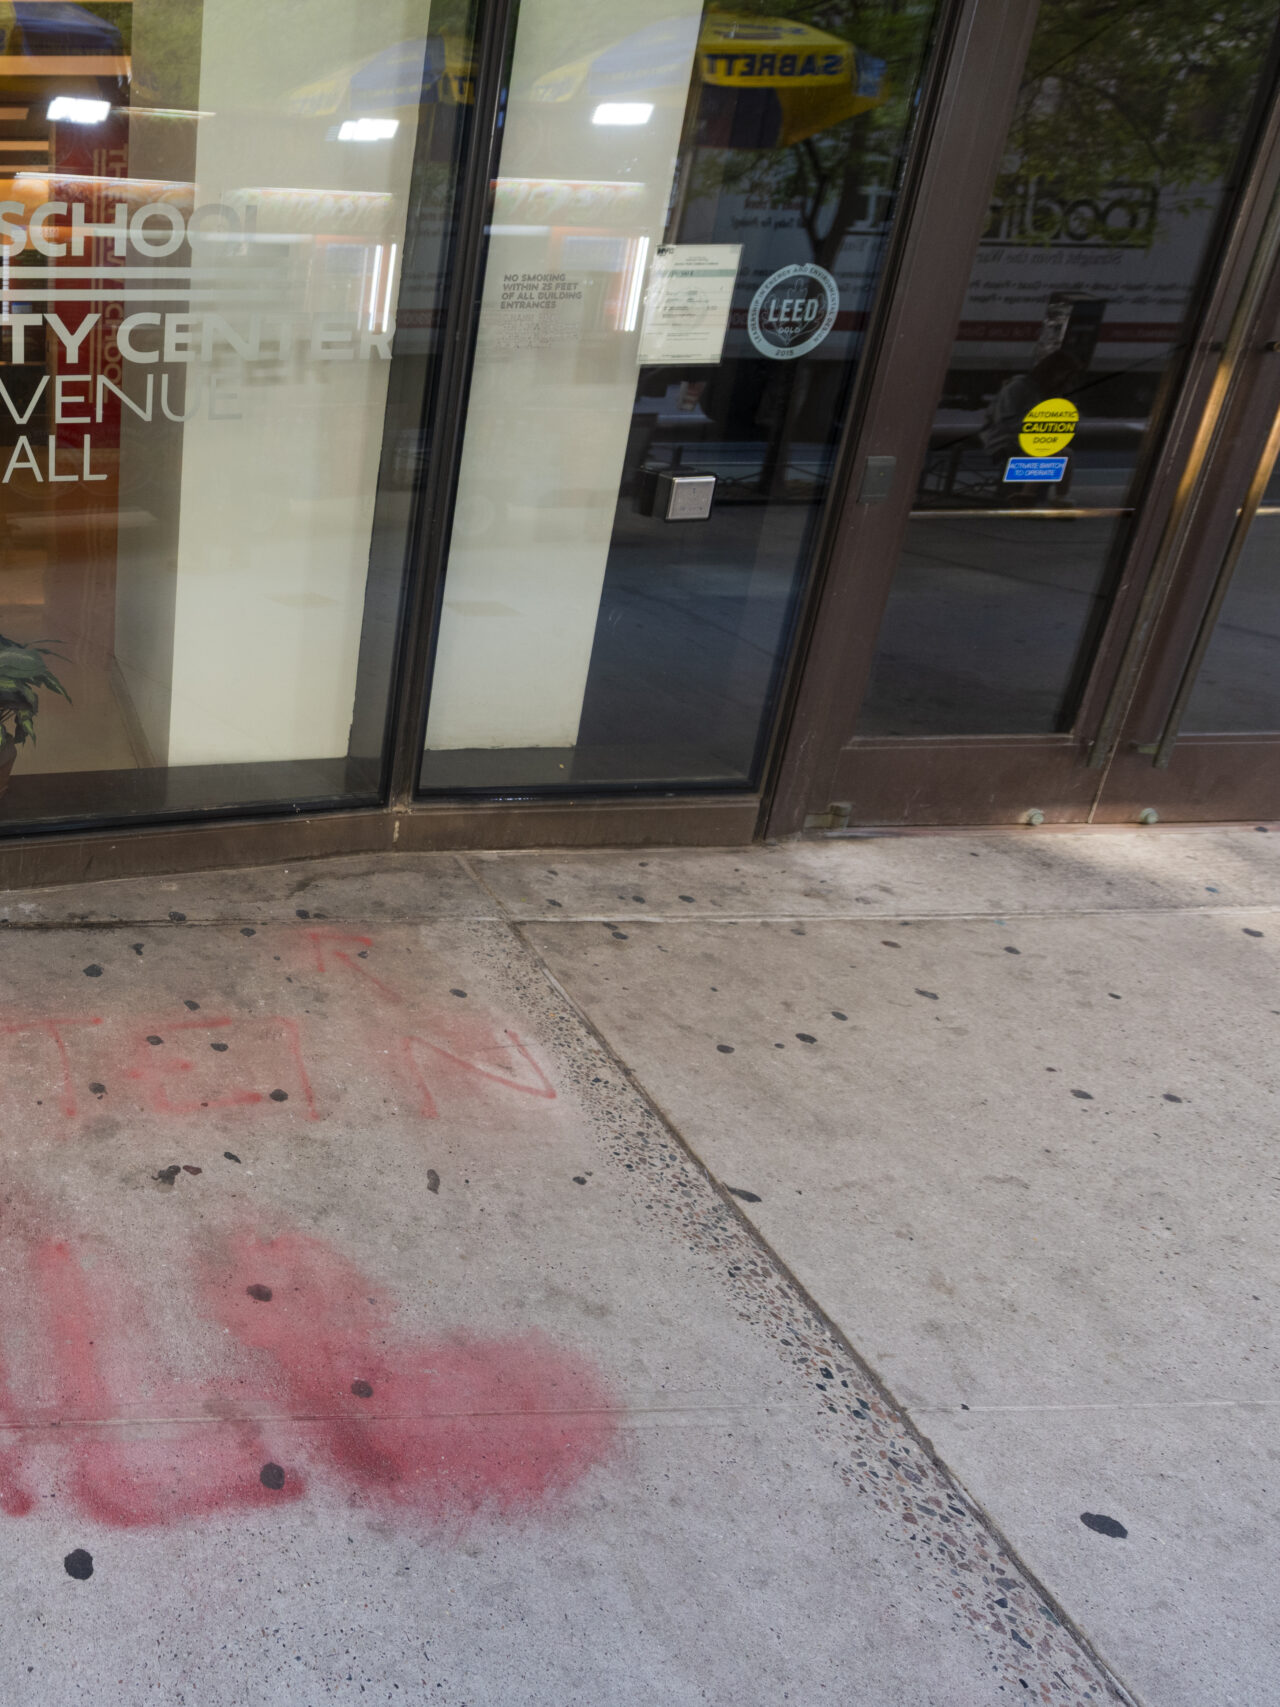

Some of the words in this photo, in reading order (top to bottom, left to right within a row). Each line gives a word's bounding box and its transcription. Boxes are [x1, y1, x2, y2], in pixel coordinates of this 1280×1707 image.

[504, 274, 519, 282] NO
[521, 274, 567, 282] SMOKING
[503, 283, 540, 291] WITHIN
[542, 283, 552, 291] 25
[555, 283, 579, 291] FEET
[502, 292, 515, 300] OF
[517, 292, 535, 300] ALL
[538, 292, 583, 300] BUILDING
[500, 301, 558, 309] ENTRANCES
[768, 299, 819, 322] LEED
[778, 326, 801, 334] GOLD
[116, 311, 397, 363] CENTER
[1029, 410, 1078, 418] AUTOMATIC
[1022, 422, 1076, 433] CAUTION
